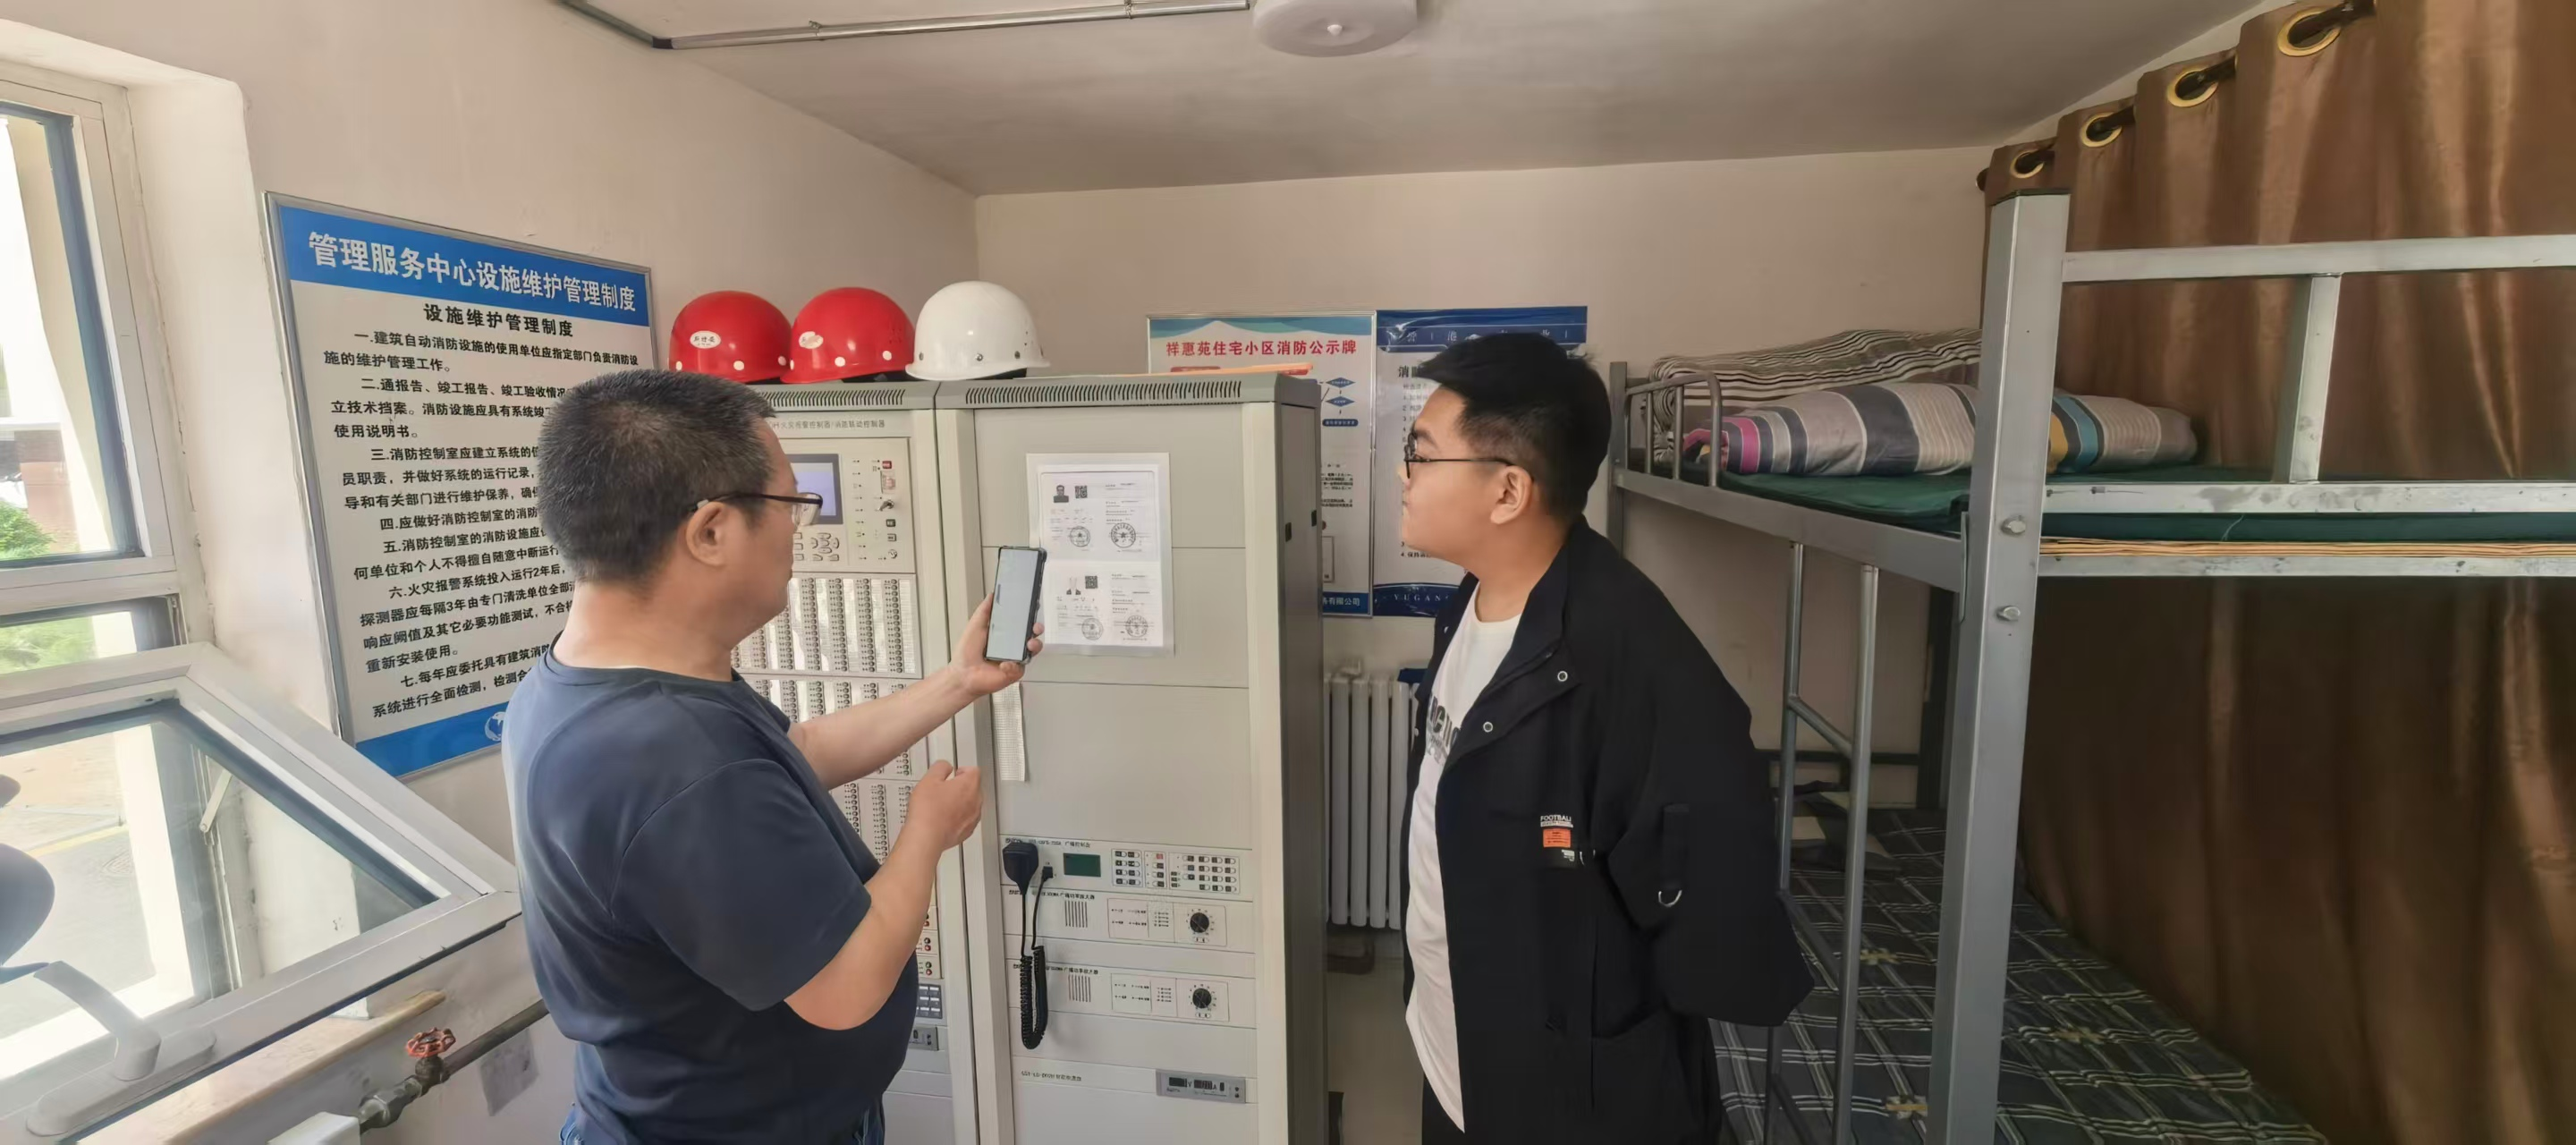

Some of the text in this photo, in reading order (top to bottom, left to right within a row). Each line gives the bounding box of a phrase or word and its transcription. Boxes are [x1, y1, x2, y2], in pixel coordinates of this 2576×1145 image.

[309, 232, 636, 311] 管理服务中心设施维护管理制度
[423, 302, 573, 337] 设施维护管理制度
[323, 350, 451, 372] 施的维护管理工作。
[354, 331, 640, 366] 一.建筑自动消防设施的使用单位应指定部门负责消防设
[1165, 339, 1358, 357] 祥惠苑住宅小区消防公示牌
[361, 377, 572, 399] 二.通报告、竣工报告、竣工验收情况
[334, 423, 419, 439] 使用说明书。
[353, 545, 559, 581] 何单位和个人不得擅自随意中断运行
[1394, 593, 1450, 602] YUGAN
[365, 644, 459, 673] 重新安装使用。
[372, 667, 532, 718] 系统进行全面检测，检测合
